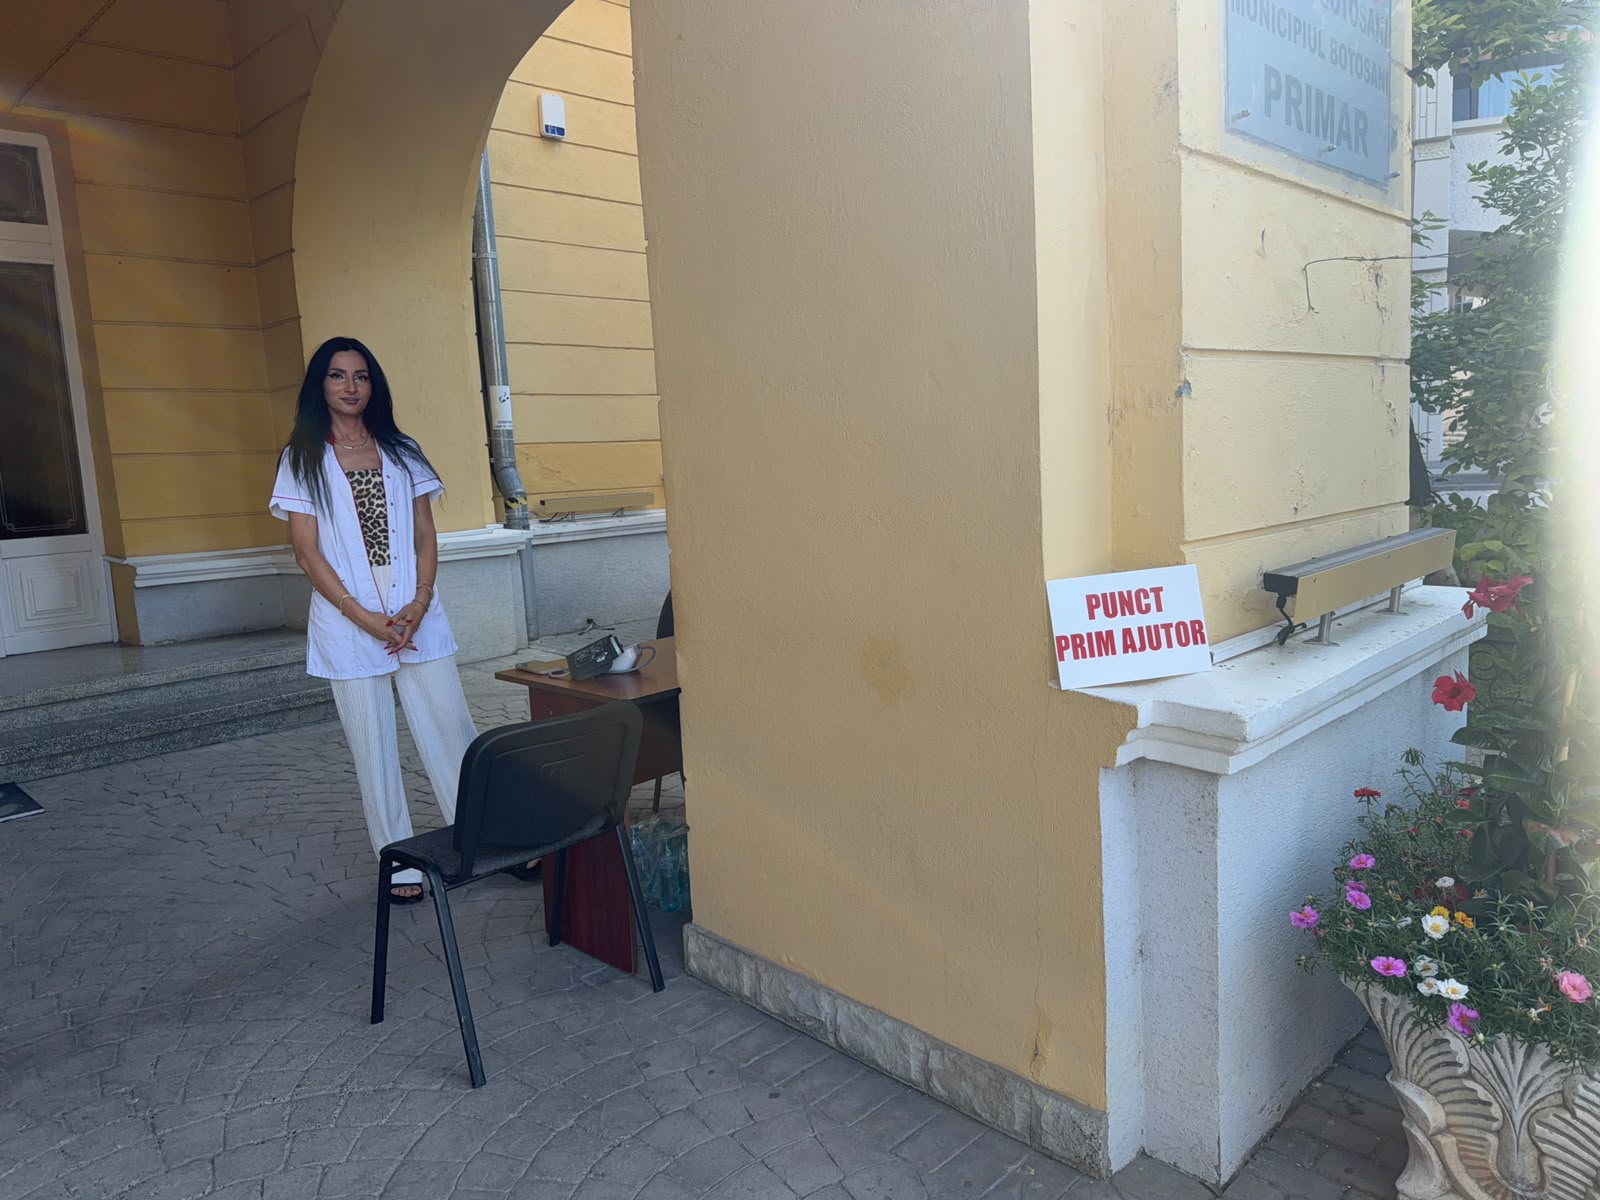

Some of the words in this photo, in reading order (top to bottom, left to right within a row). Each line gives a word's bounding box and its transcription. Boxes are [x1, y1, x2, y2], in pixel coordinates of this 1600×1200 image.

[1329, 37, 1389, 97] BOTOSANI
[1264, 63, 1369, 158] PRIMAR
[1085, 586, 1164, 620] PUNCT
[1055, 629, 1117, 662] PRIM
[1122, 619, 1207, 654] AJUTOR
